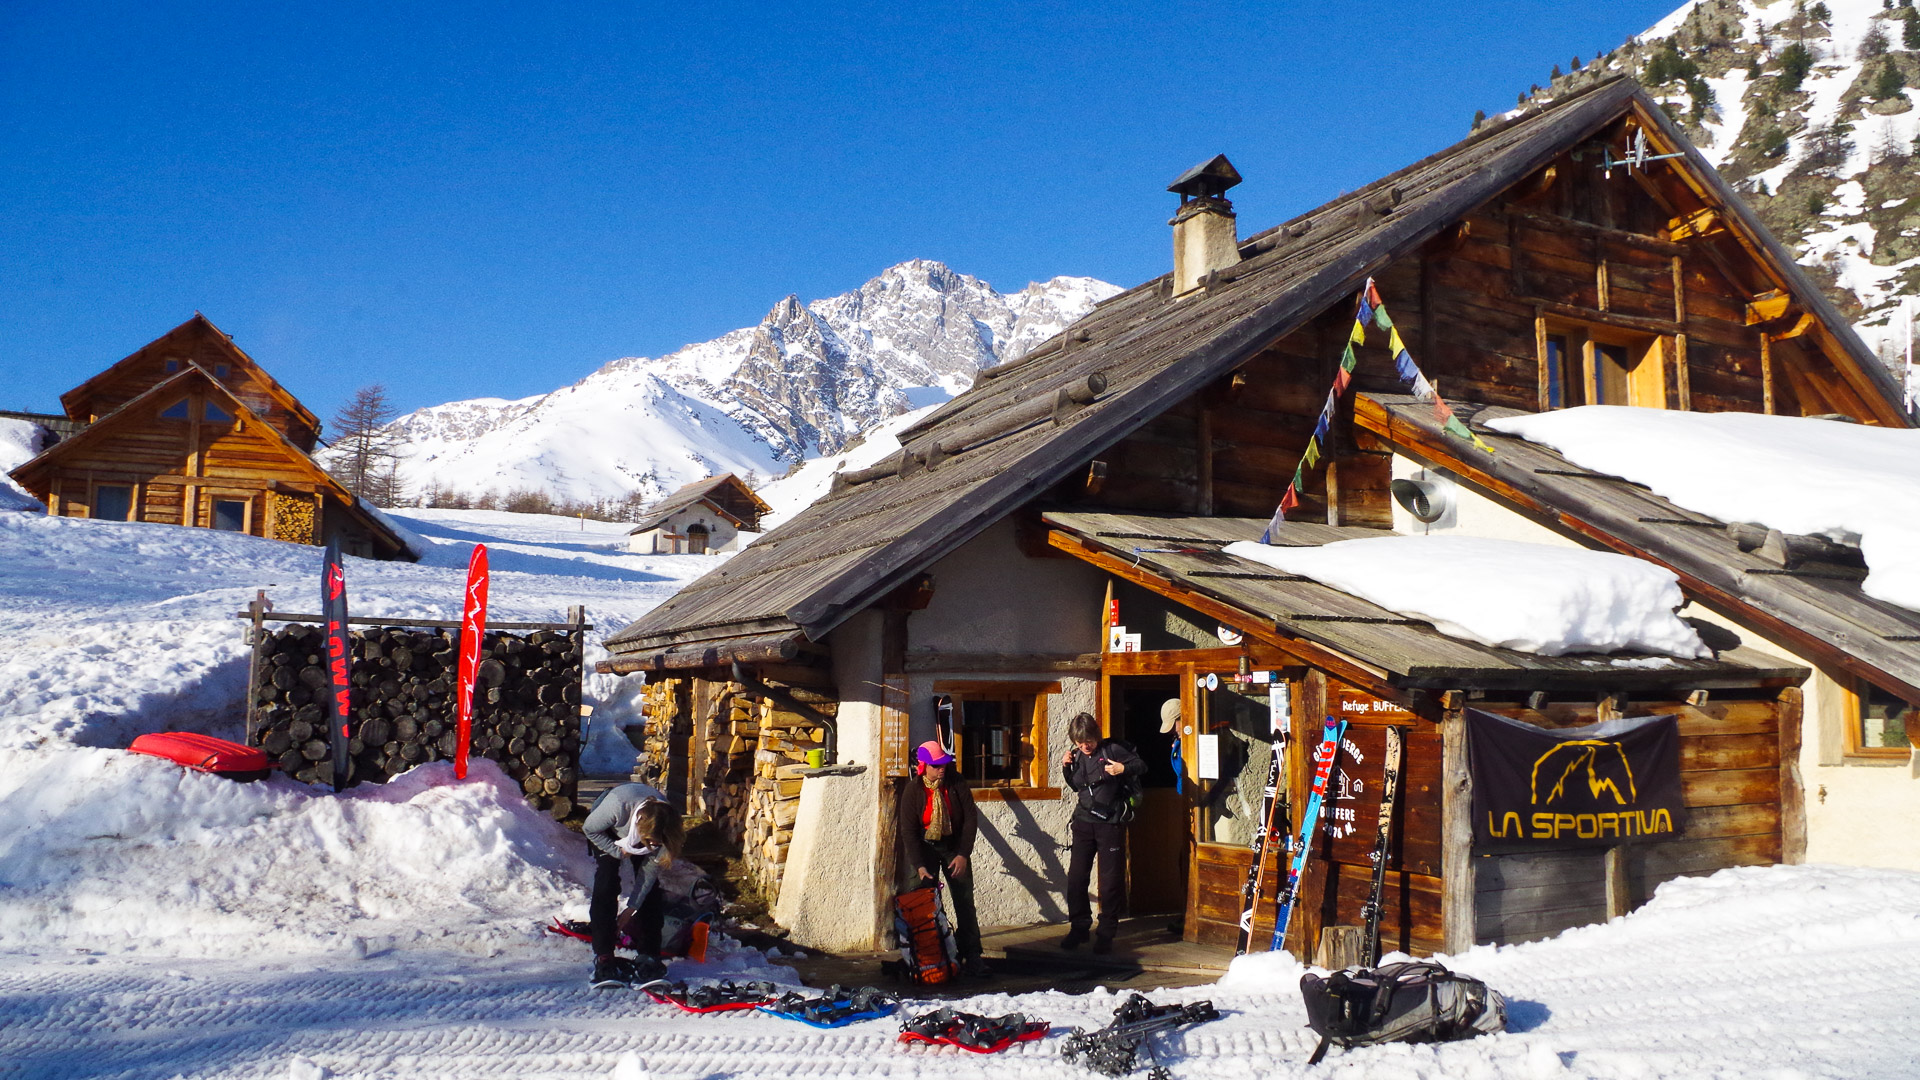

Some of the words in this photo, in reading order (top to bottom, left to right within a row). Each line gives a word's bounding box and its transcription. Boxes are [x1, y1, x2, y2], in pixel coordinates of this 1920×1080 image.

[1342, 700, 1369, 714] Refuge
[1267, 759, 1278, 787] PLUM
[1320, 805, 1355, 822] BUFFERE
[1322, 822, 1343, 839] 2076
[1488, 810, 1524, 838] LA
[1531, 808, 1673, 839] SPORTIVA
